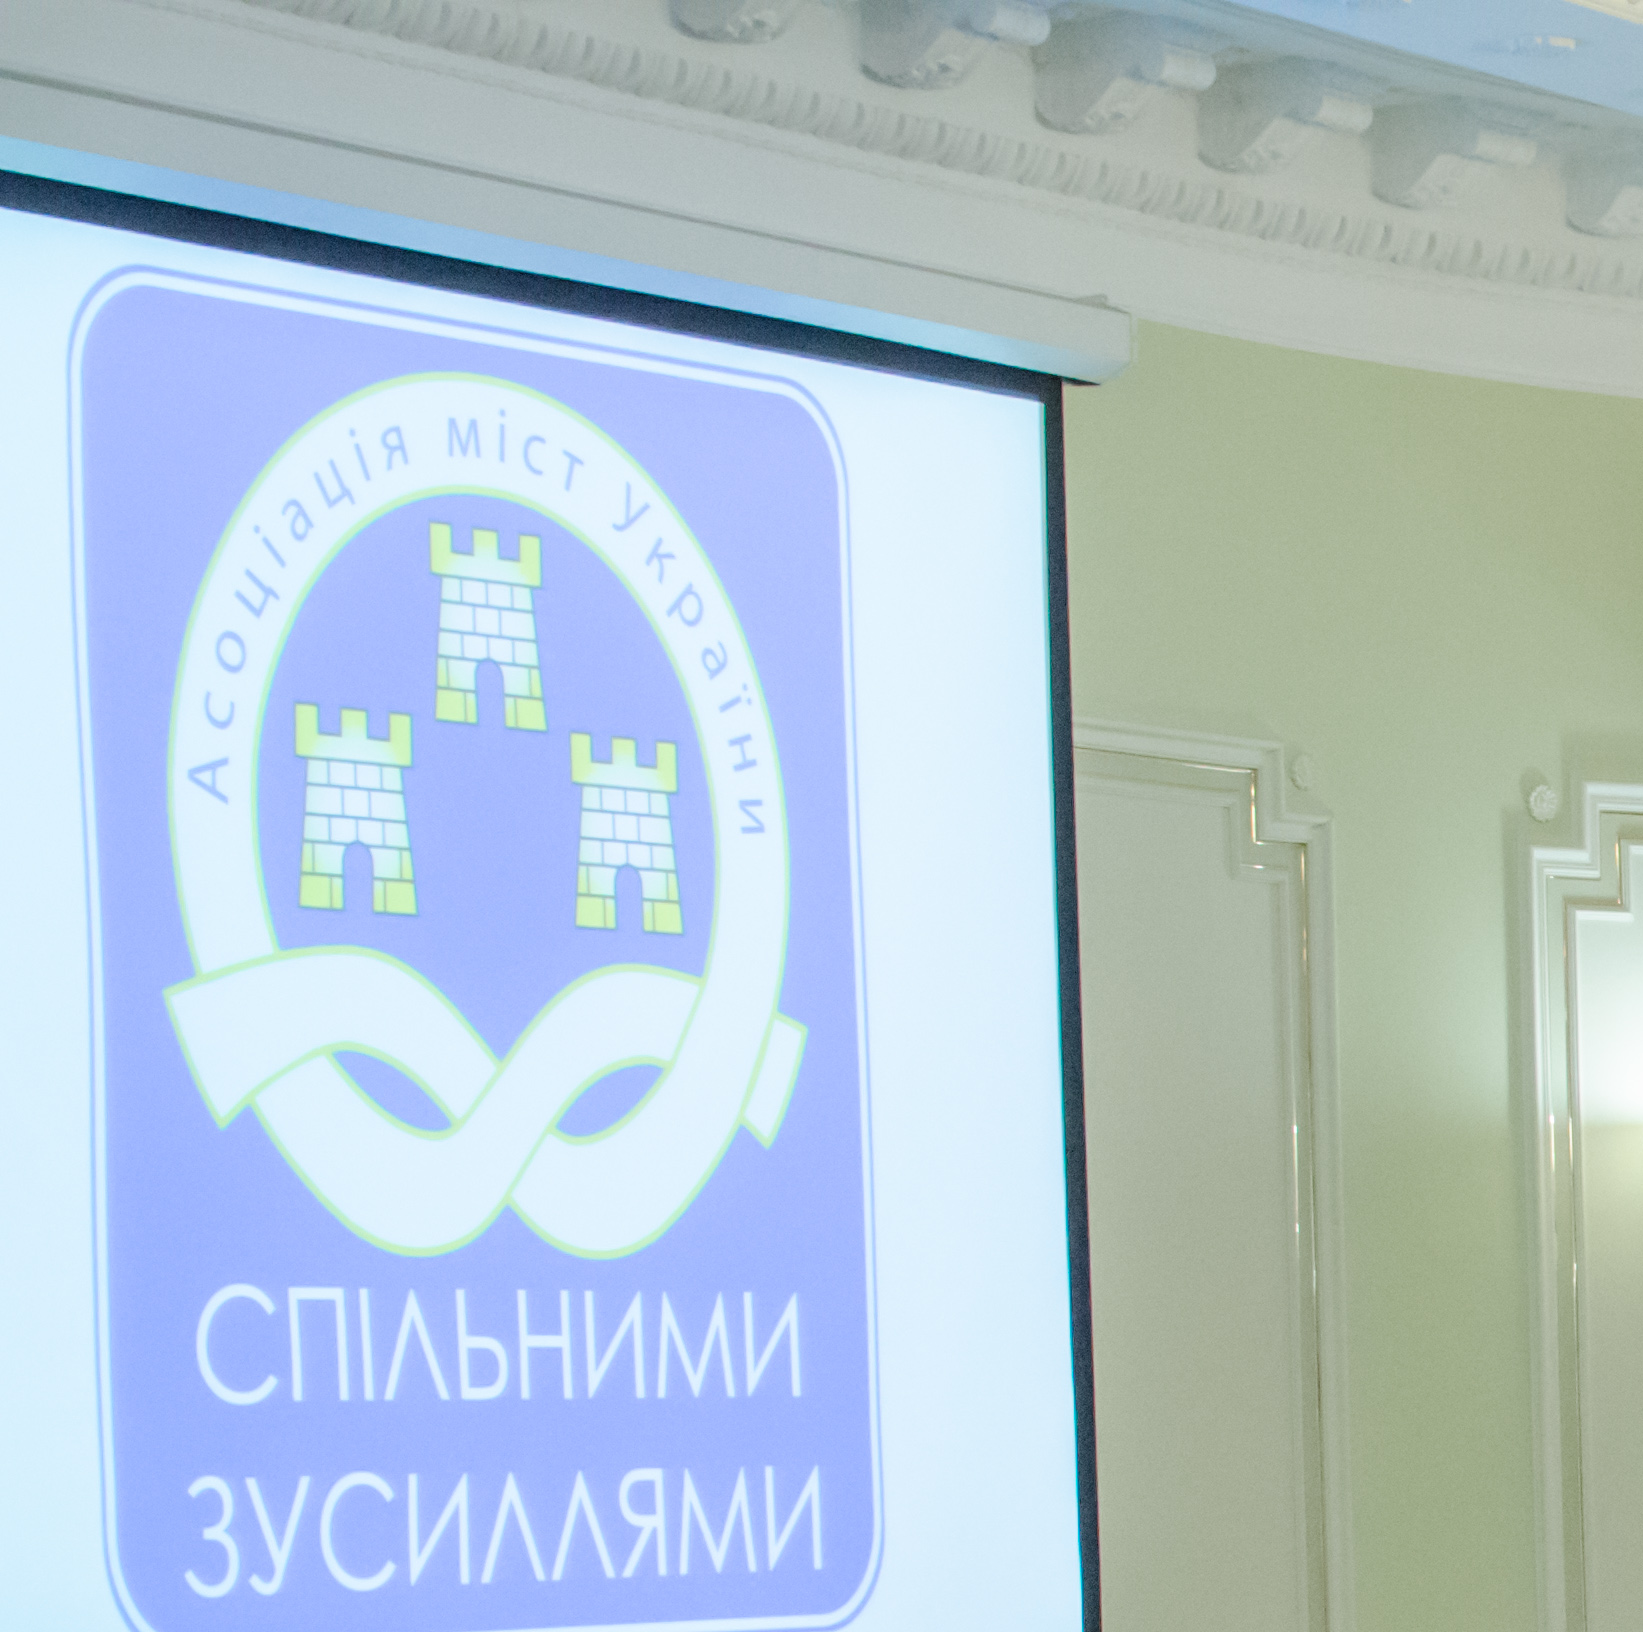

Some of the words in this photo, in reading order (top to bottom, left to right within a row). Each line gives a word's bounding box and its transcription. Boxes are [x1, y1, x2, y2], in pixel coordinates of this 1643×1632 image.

[187, 425, 411, 806] Асоціація
[447, 408, 585, 492] міст
[612, 481, 766, 835] України
[195, 1283, 802, 1405] СПІЛЬНИМИ
[184, 1464, 823, 1597] ЗУСИЛЛЯМИ
